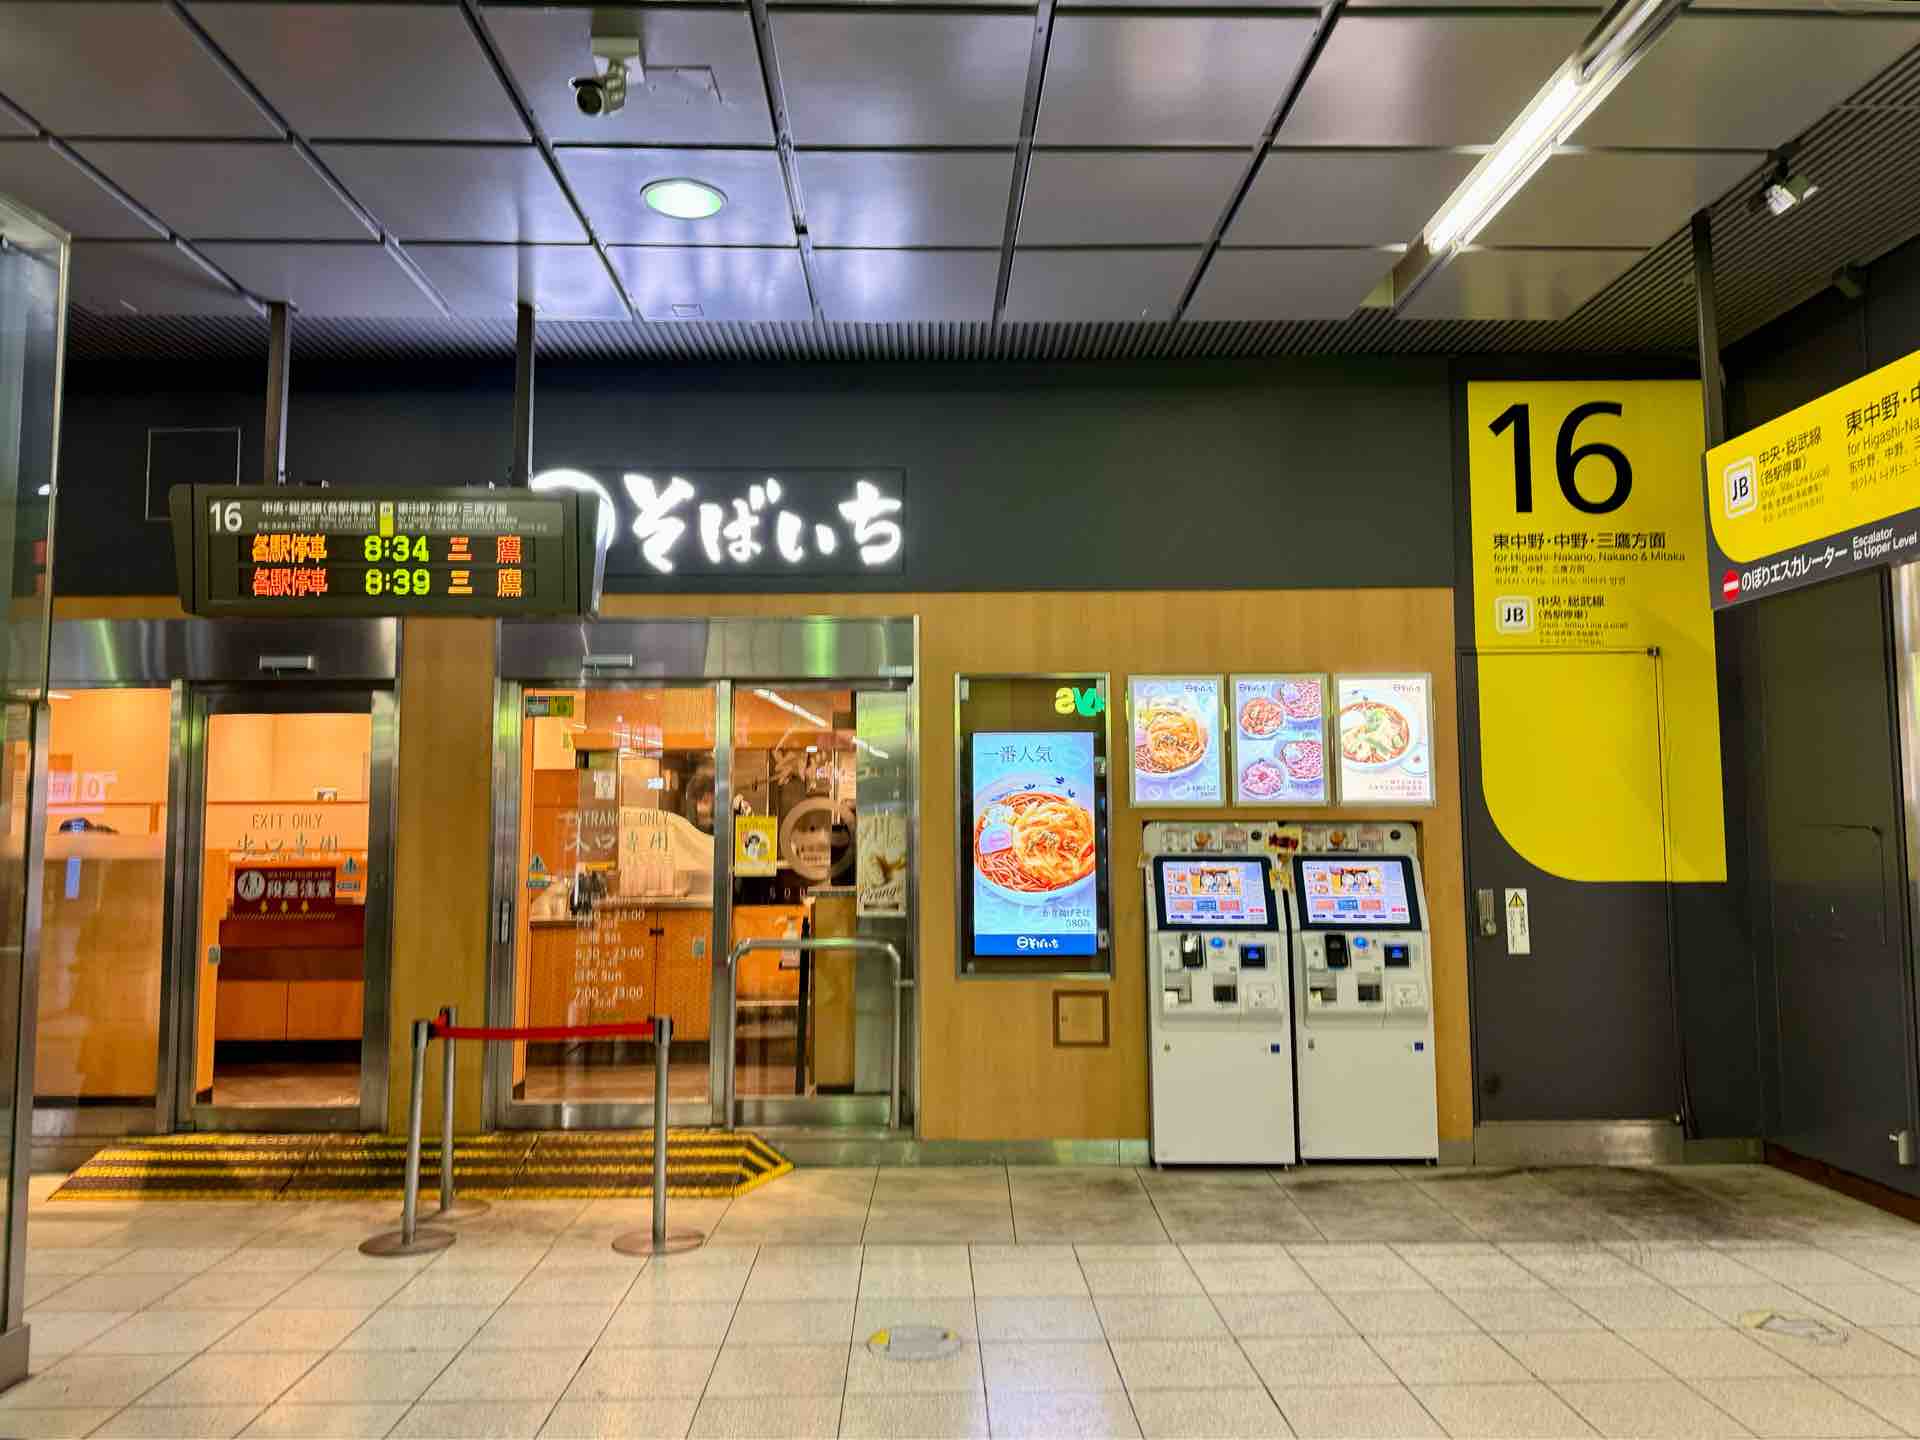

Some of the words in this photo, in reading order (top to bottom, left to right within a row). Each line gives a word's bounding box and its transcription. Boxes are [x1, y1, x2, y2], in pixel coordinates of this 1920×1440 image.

[1488, 401, 1633, 514] 16
[1732, 476, 1749, 501] JB
[209, 502, 243, 533] 16
[623, 473, 902, 574] そばいち
[252, 533, 328, 563] 各駅停車
[364, 535, 429, 562] 8:34
[1852, 528, 1894, 548] Escalator
[1853, 550, 1862, 561] to
[1864, 541, 1892, 559] Upper
[1893, 532, 1918, 549] Level
[365, 568, 430, 595] 8:39
[1741, 546, 1848, 592] のぼりエスカレーター
[1504, 607, 1525, 623] JB
[984, 745, 1054, 763] 一番人気
[252, 814, 284, 830] EXIT
[292, 814, 323, 830] ONLY
